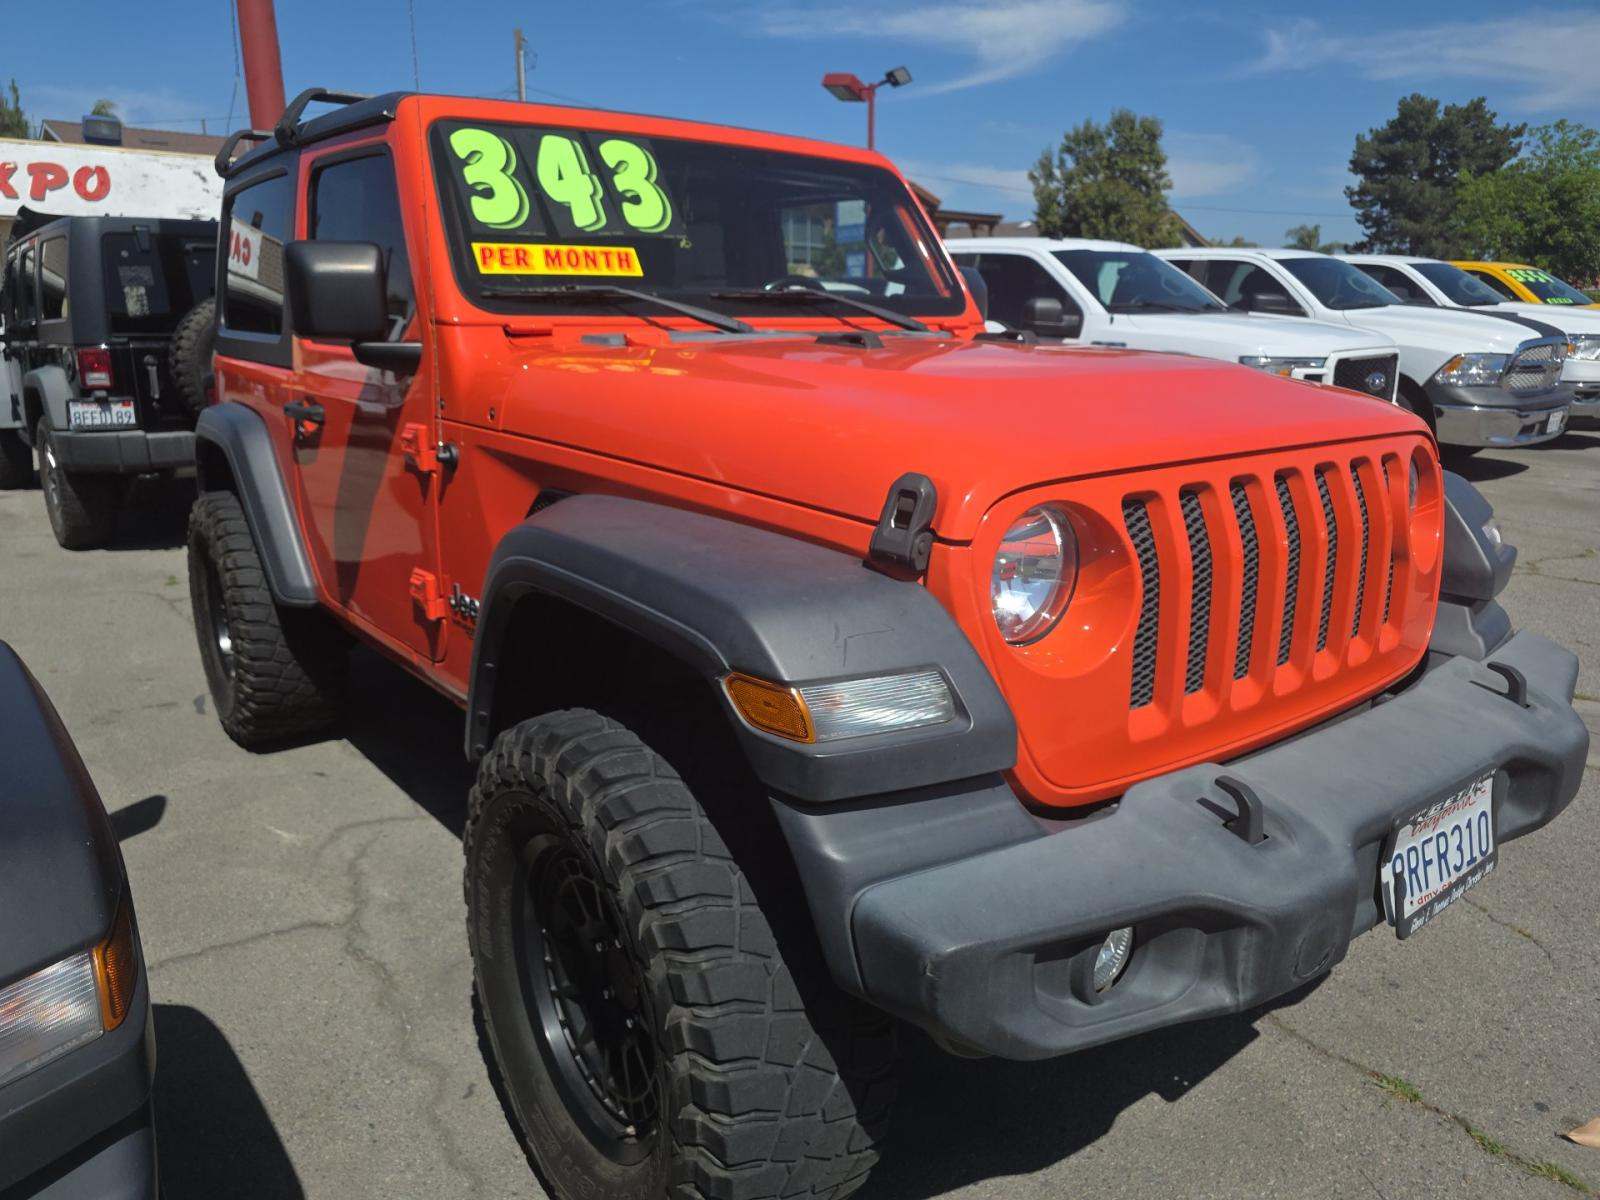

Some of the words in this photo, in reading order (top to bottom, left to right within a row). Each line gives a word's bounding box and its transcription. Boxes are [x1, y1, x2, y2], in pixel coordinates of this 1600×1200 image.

[449, 127, 673, 234] 343
[480, 246, 528, 267] PER
[544, 248, 632, 270] MONTH
